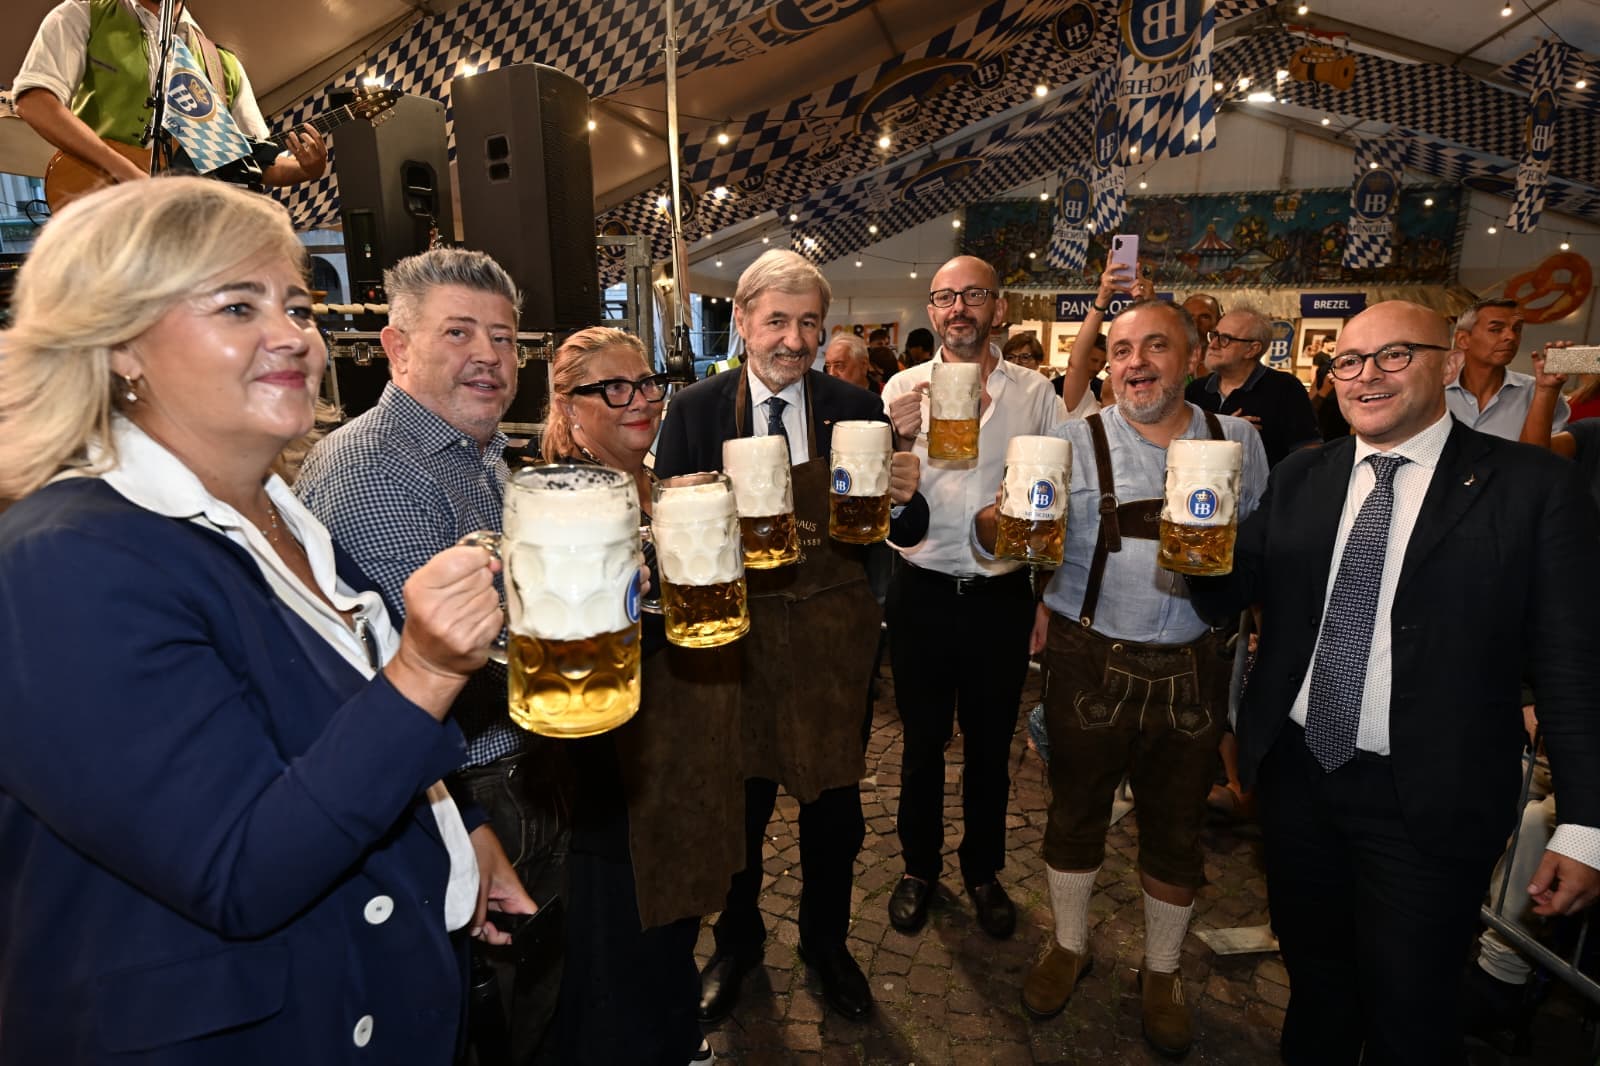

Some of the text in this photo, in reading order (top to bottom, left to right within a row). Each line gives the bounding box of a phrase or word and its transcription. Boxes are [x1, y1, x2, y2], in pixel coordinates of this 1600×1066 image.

[168, 84, 198, 112] HB
[1363, 194, 1387, 213] HB
[1313, 300, 1350, 310] BREZEL
[1194, 502, 1211, 515] HB
